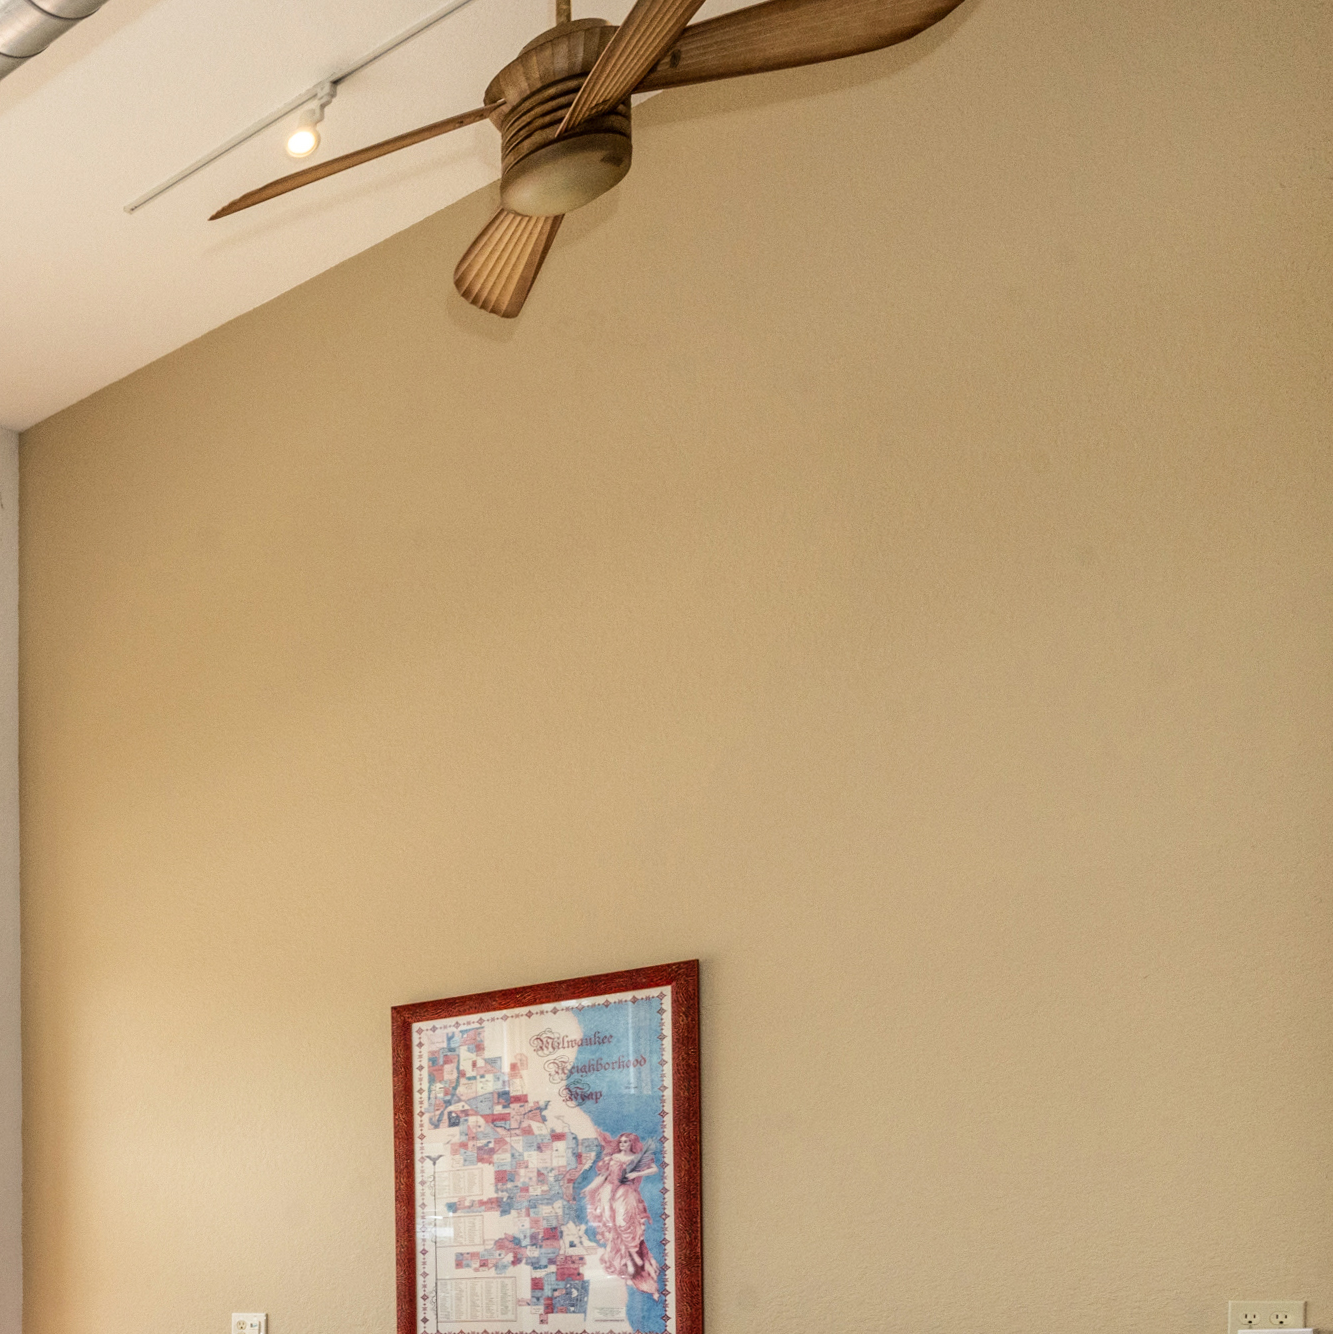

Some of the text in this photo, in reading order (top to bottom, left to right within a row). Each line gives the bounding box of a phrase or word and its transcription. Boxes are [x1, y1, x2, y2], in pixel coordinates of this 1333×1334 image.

[529, 1028, 613, 1057] Milwaukee
[544, 1054, 647, 1084] Neighborhood
[560, 1080, 603, 1107] Map
